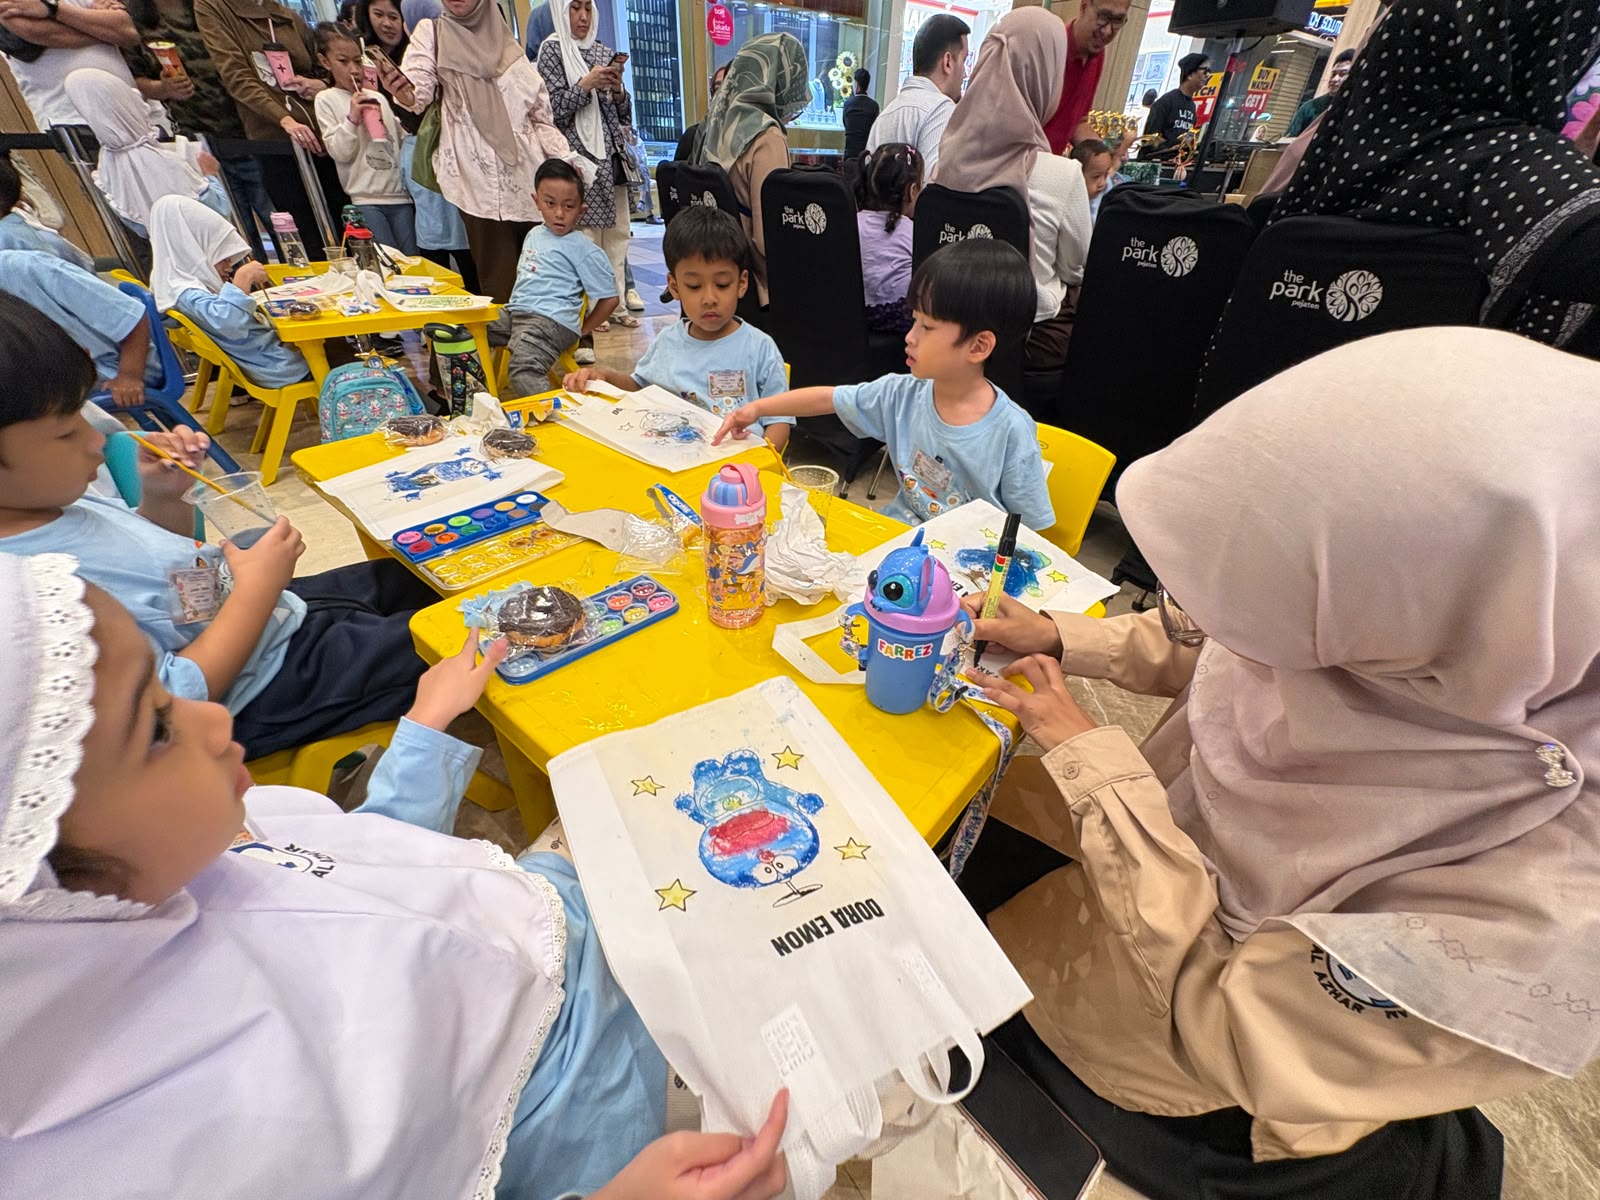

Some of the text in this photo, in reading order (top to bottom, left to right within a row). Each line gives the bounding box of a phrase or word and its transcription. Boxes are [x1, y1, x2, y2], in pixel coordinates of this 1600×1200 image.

[784, 205, 794, 214] the
[782, 211, 805, 225] park
[945, 223, 956, 233] the
[939, 230, 966, 244] park
[1130, 236, 1146, 248] the
[1121, 244, 1160, 262] park
[1283, 269, 1305, 283] the
[1268, 280, 1324, 302] park
[1291, 300, 1320, 310] pejaten
[878, 638, 934, 661] FARREZ
[310, 865, 336, 879] AL
[770, 898, 886, 957] DORA EMON
[1310, 943, 1366, 1015] AL AZHAR
